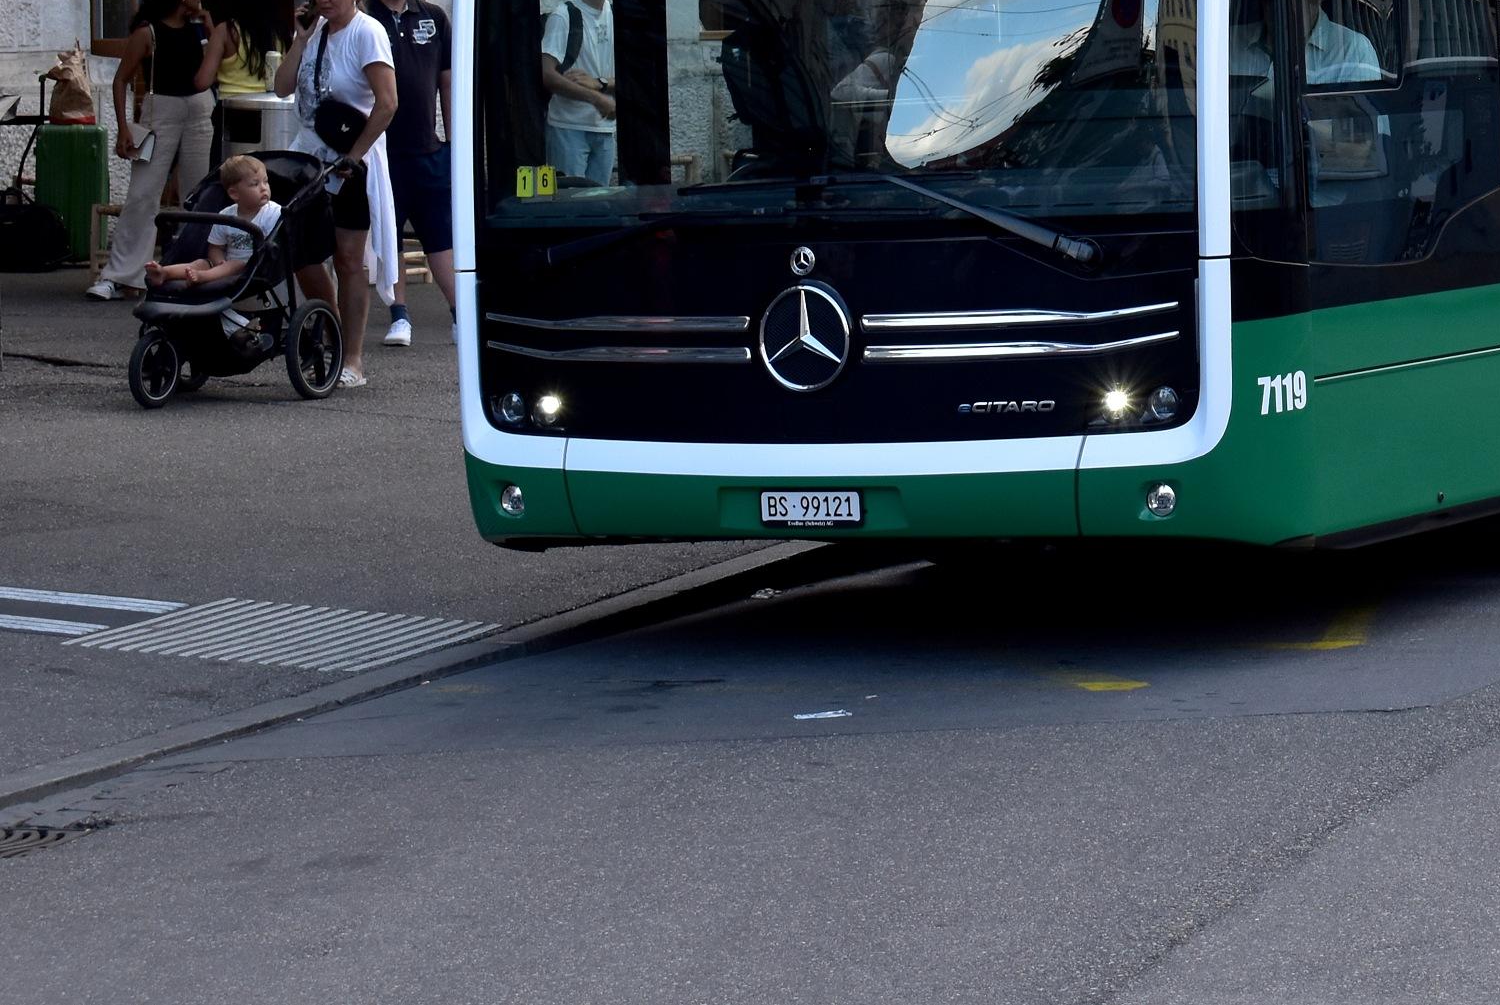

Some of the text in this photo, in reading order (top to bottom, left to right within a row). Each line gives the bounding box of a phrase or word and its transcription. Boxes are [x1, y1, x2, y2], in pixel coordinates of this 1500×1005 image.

[522, 173, 548, 190] 1 6
[1257, 370, 1307, 415] 7119
[768, 496, 853, 517] BS 99121
